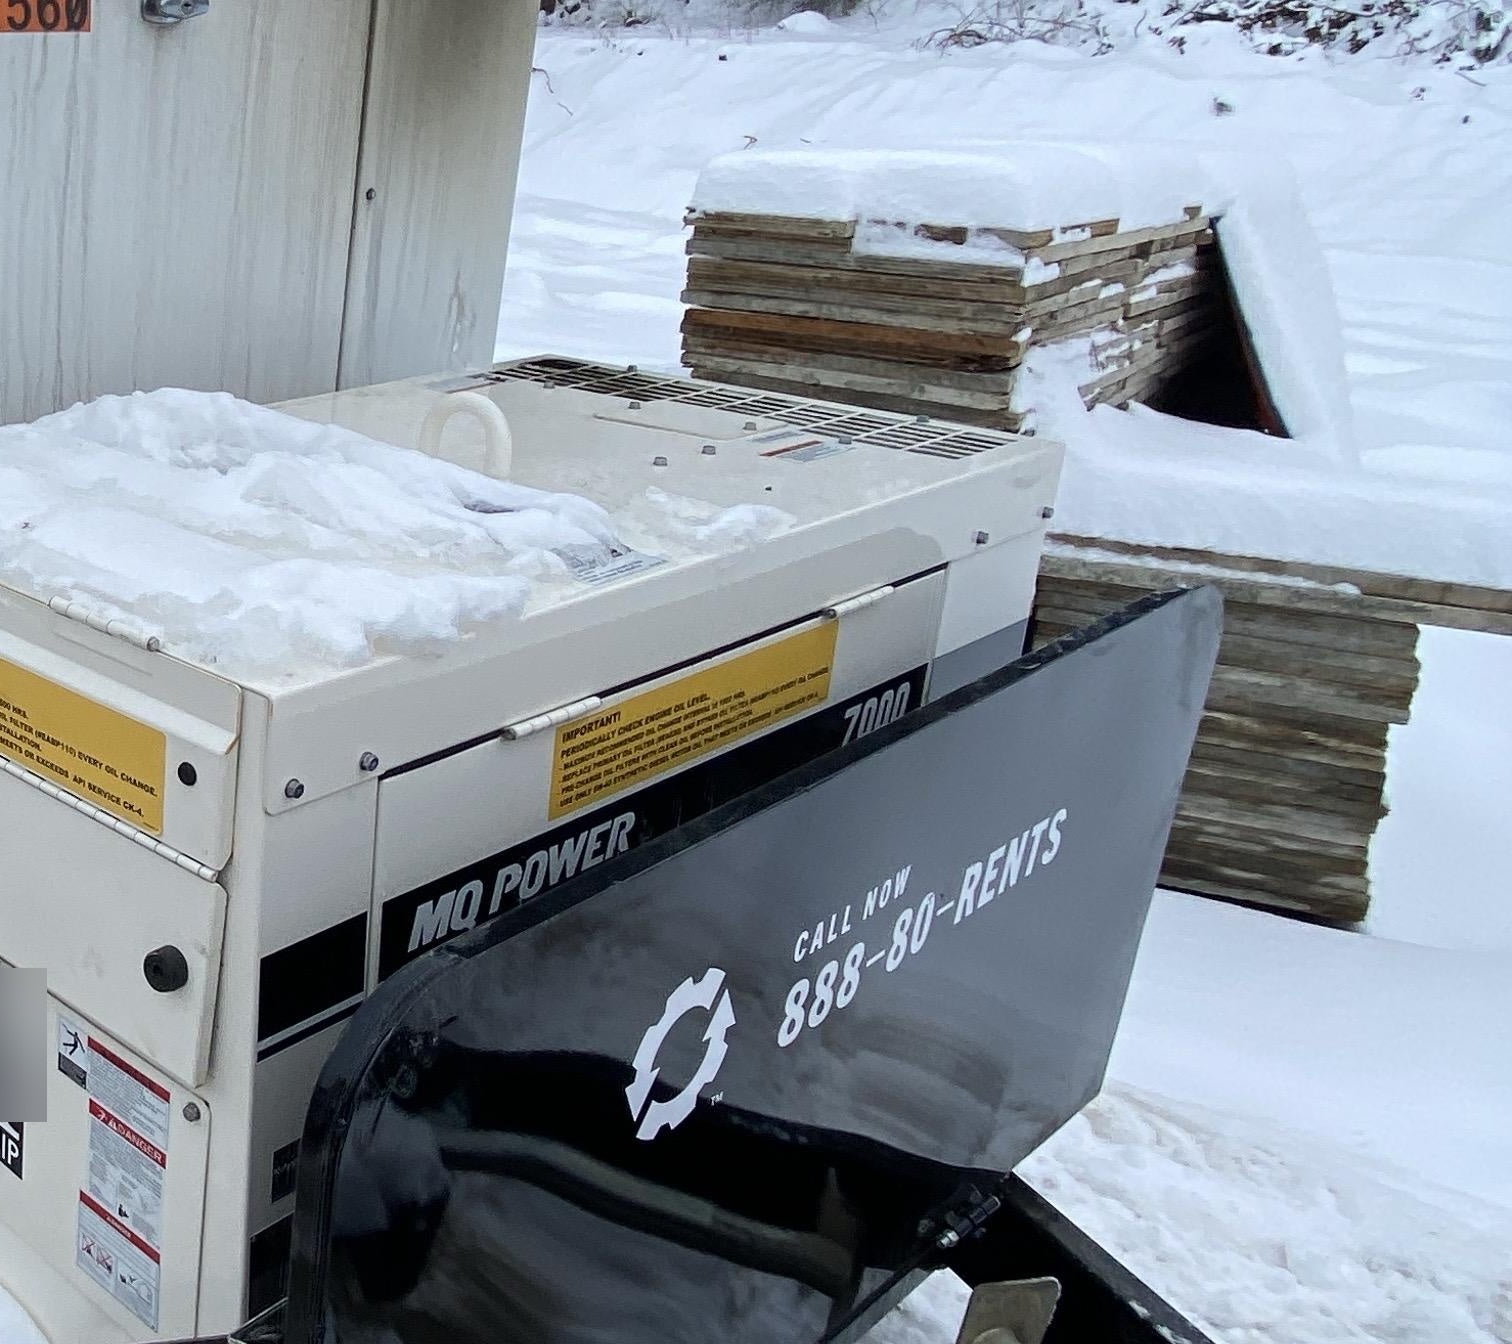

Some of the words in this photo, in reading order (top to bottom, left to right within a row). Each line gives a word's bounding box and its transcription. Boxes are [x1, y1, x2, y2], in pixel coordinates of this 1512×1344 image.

[563, 710, 621, 742] IMPORTANT!
[842, 681, 911, 748] 7000
[408, 879, 483, 953] MQ
[489, 811, 636, 915] POWER
[794, 905, 851, 963] CALL
[862, 864, 912, 921] NOW
[778, 808, 1067, 1047] 888-80-RENTS
[117, 1122, 163, 1164] DANGER
